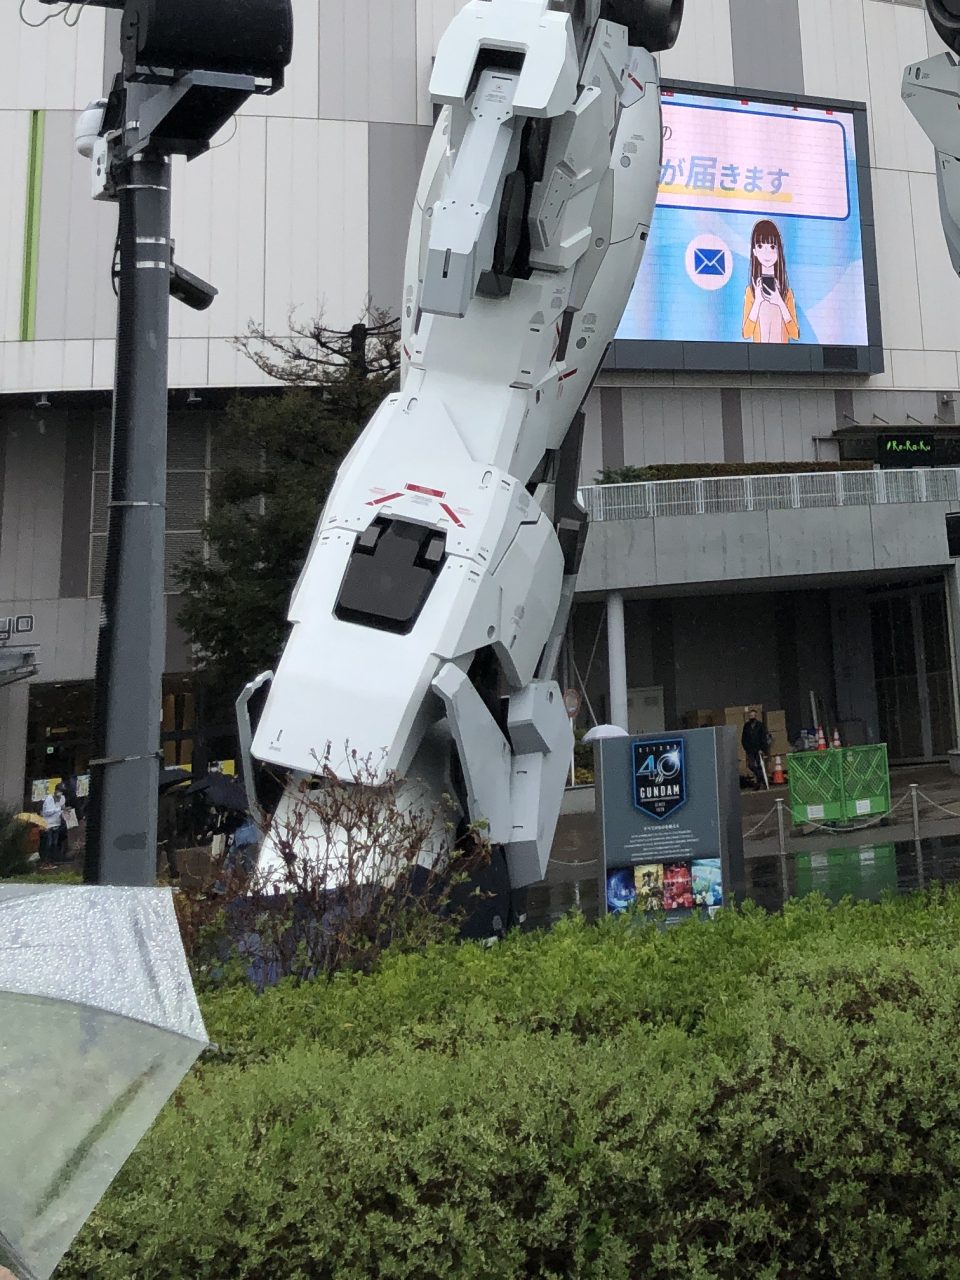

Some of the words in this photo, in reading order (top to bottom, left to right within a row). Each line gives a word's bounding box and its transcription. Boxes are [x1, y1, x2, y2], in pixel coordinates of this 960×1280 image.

[659, 155, 790, 195] が届きます
[640, 783, 680, 799] GUNDAM
